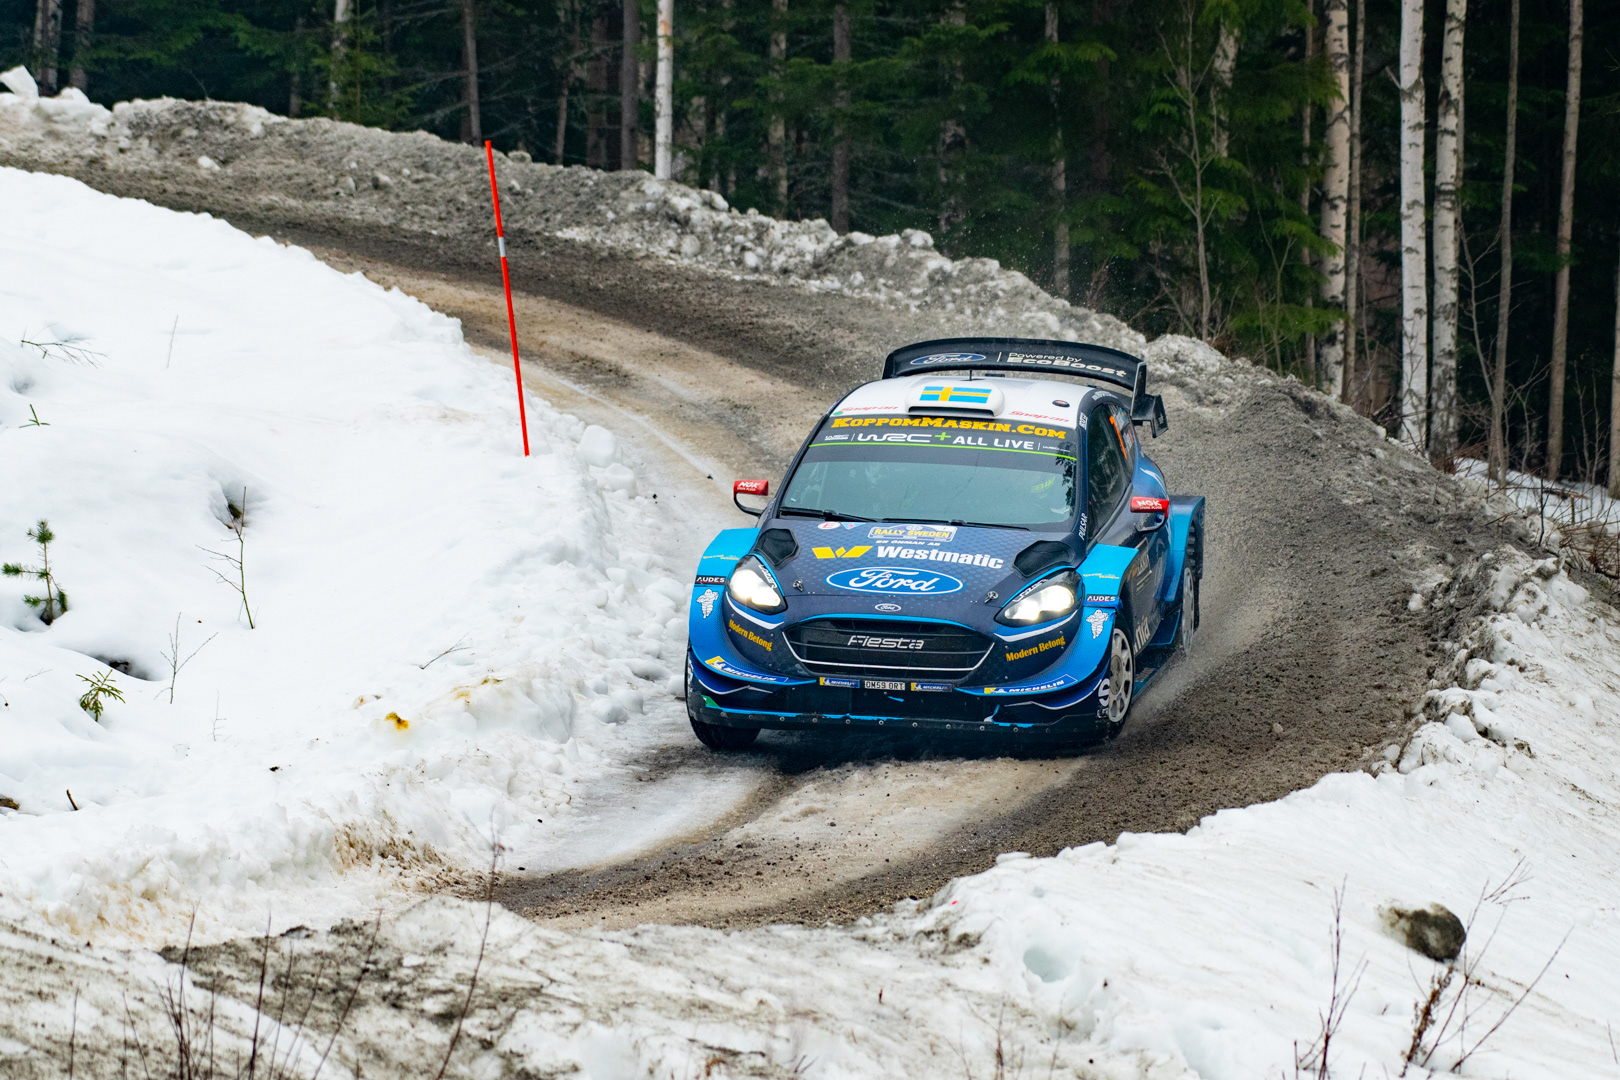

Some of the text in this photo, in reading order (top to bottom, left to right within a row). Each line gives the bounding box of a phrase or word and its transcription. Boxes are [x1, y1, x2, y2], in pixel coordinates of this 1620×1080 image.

[927, 353, 974, 364] Ford
[1009, 352, 1082, 364] Powered by
[1007, 357, 1127, 378] EcoBoost
[953, 435, 988, 446] ALL
[993, 438, 1034, 450] LIVE
[907, 530, 950, 538] SWEDEN
[877, 545, 1004, 569] Westmatic
[849, 569, 941, 592] Ford
[729, 619, 773, 652] Modern Betong
[847, 635, 925, 650] Fiesta
[1005, 635, 1066, 662] Modern Betong
[723, 666, 777, 681] MICHELIN
[1009, 680, 1065, 693] MICHELIN
